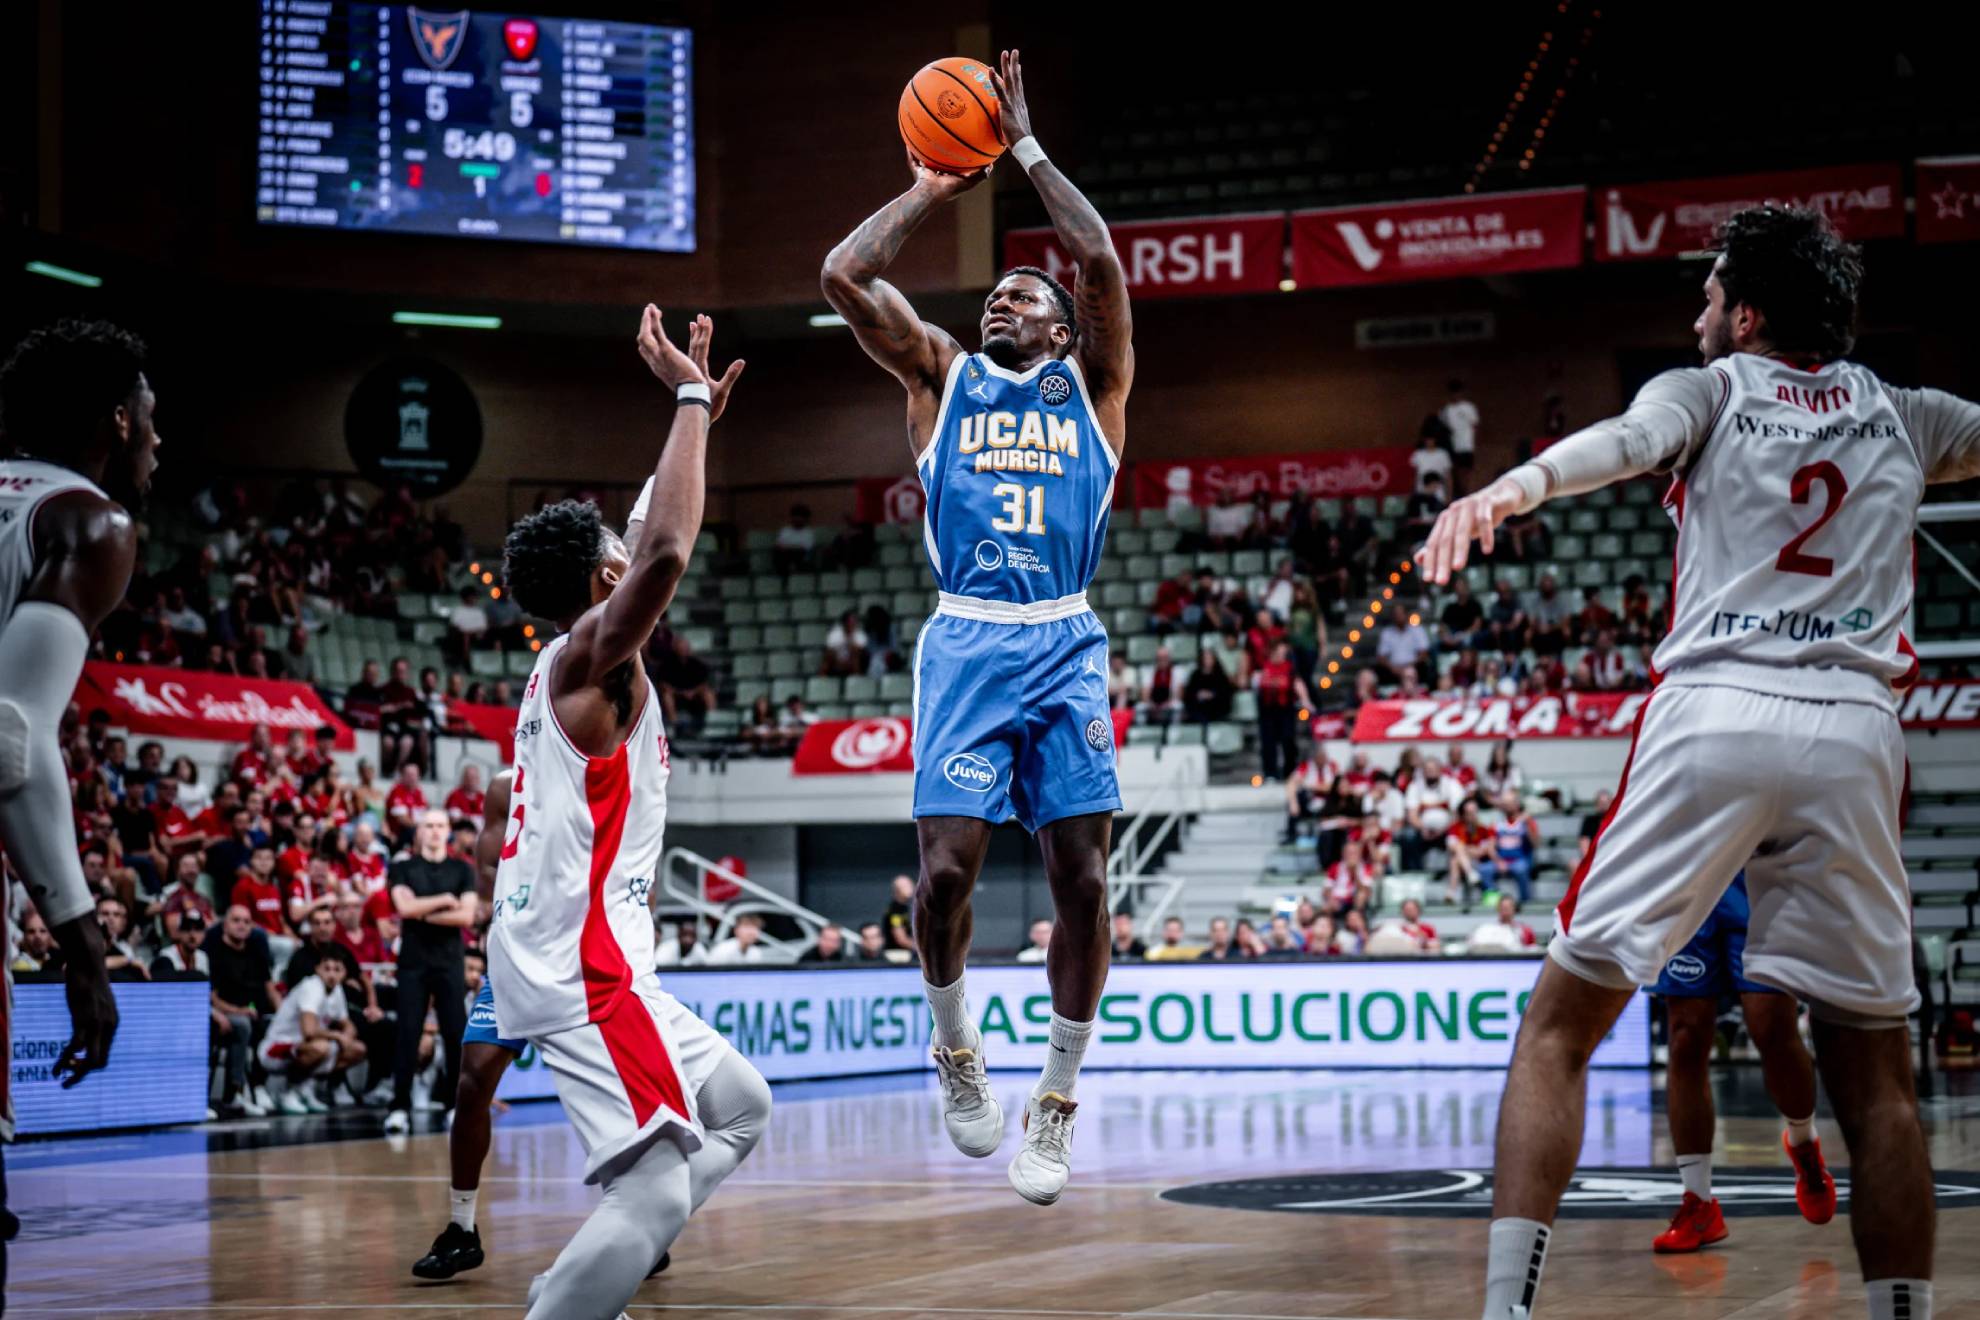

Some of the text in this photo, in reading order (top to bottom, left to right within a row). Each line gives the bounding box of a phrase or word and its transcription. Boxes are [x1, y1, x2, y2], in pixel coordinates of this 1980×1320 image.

[426, 85, 448, 121] 5
[510, 91, 533, 127] 5
[1046, 232, 1243, 287] MRSH
[959, 411, 1079, 458] UCAM
[975, 450, 1064, 477] MURCIA
[992, 482, 1046, 536] 31
[1775, 460, 1848, 578] 2
[949, 763, 994, 783] Juver
[682, 1000, 811, 1055] EMAS
[826, 995, 1051, 1051] NUESTAS
